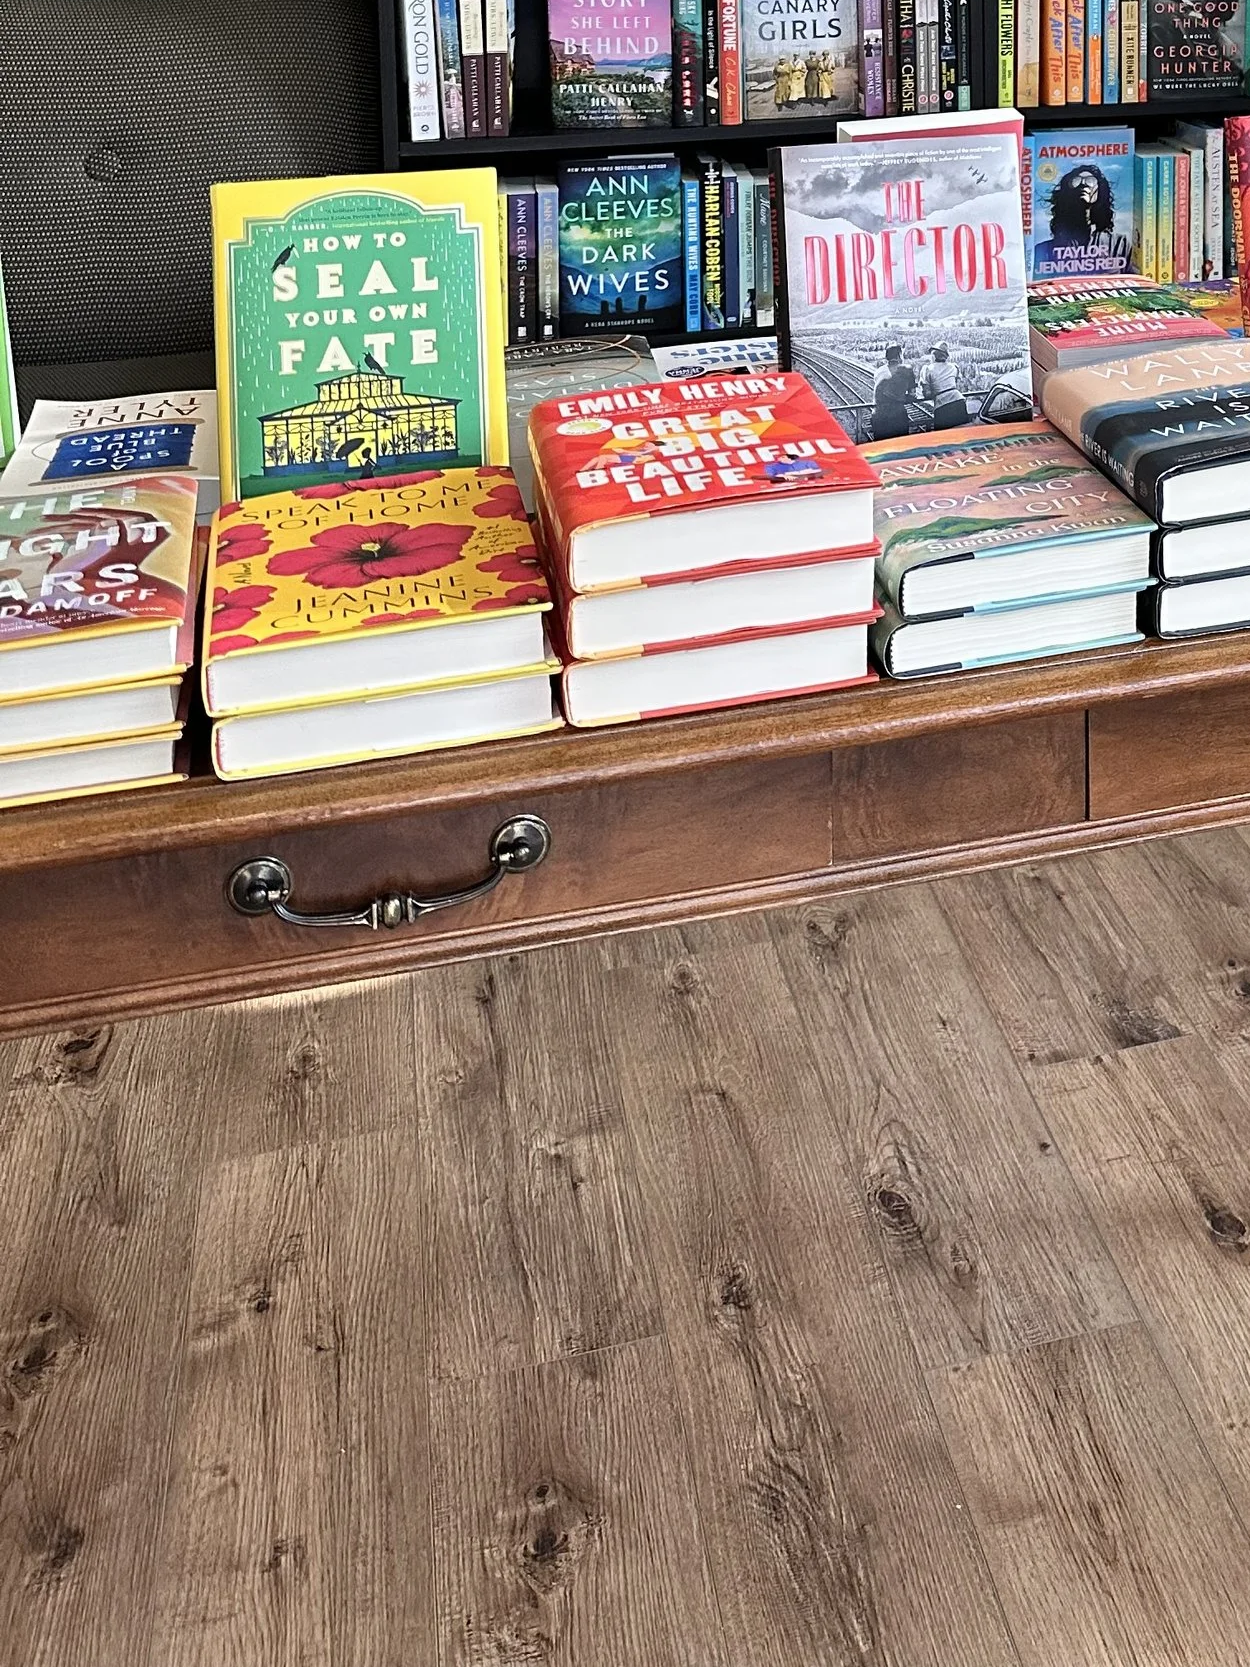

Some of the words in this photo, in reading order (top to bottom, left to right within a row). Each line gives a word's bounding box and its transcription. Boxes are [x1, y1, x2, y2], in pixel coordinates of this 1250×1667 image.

[1154, 2, 1185, 13] ONE
[1193, 1, 1239, 13] GOOD
[571, 16, 601, 29] SHE
[612, 16, 651, 29] LEFT
[758, 18, 842, 41] GIRLS
[1173, 17, 1222, 29] THING
[413, 32, 429, 76] GOLD
[563, 37, 659, 56] BEHIND
[1153, 44, 1239, 58] GEORGIA
[1161, 61, 1232, 75] HUNTER
[559, 84, 593, 94] PATTI
[598, 83, 664, 94] CALLAHAN
[591, 97, 634, 107] HENRY
[1038, 143, 1129, 158] ATMOSPHERE
[586, 174, 649, 197] ANN
[562, 197, 674, 223] CLEEVES
[881, 180, 926, 224] THE
[303, 234, 362, 253] HOW
[373, 232, 407, 249] TO
[605, 227, 633, 239] THE
[582, 242, 657, 265] DARK
[804, 222, 1008, 306] DIRECTOR
[273, 256, 439, 303] SEAL
[567, 268, 670, 296] WIVES
[285, 308, 358, 328] YOUR
[369, 302, 428, 322] OWN
[278, 329, 439, 376] FATE
[558, 388, 661, 419] EMILY
[680, 376, 789, 401] HENRY
[611, 404, 777, 440] GREAT
[658, 427, 762, 458] BIG
[576, 438, 847, 490] BEAUTIFUL
[879, 452, 1006, 480] AWAKE
[625, 466, 756, 504] LIFE
[241, 498, 358, 523] SPEAK
[371, 487, 428, 503] TO
[441, 479, 494, 496] ME
[882, 479, 1074, 520] FLOATING
[1024, 490, 1111, 514] CITY
[277, 516, 329, 531] OF
[349, 496, 471, 523] HOME
